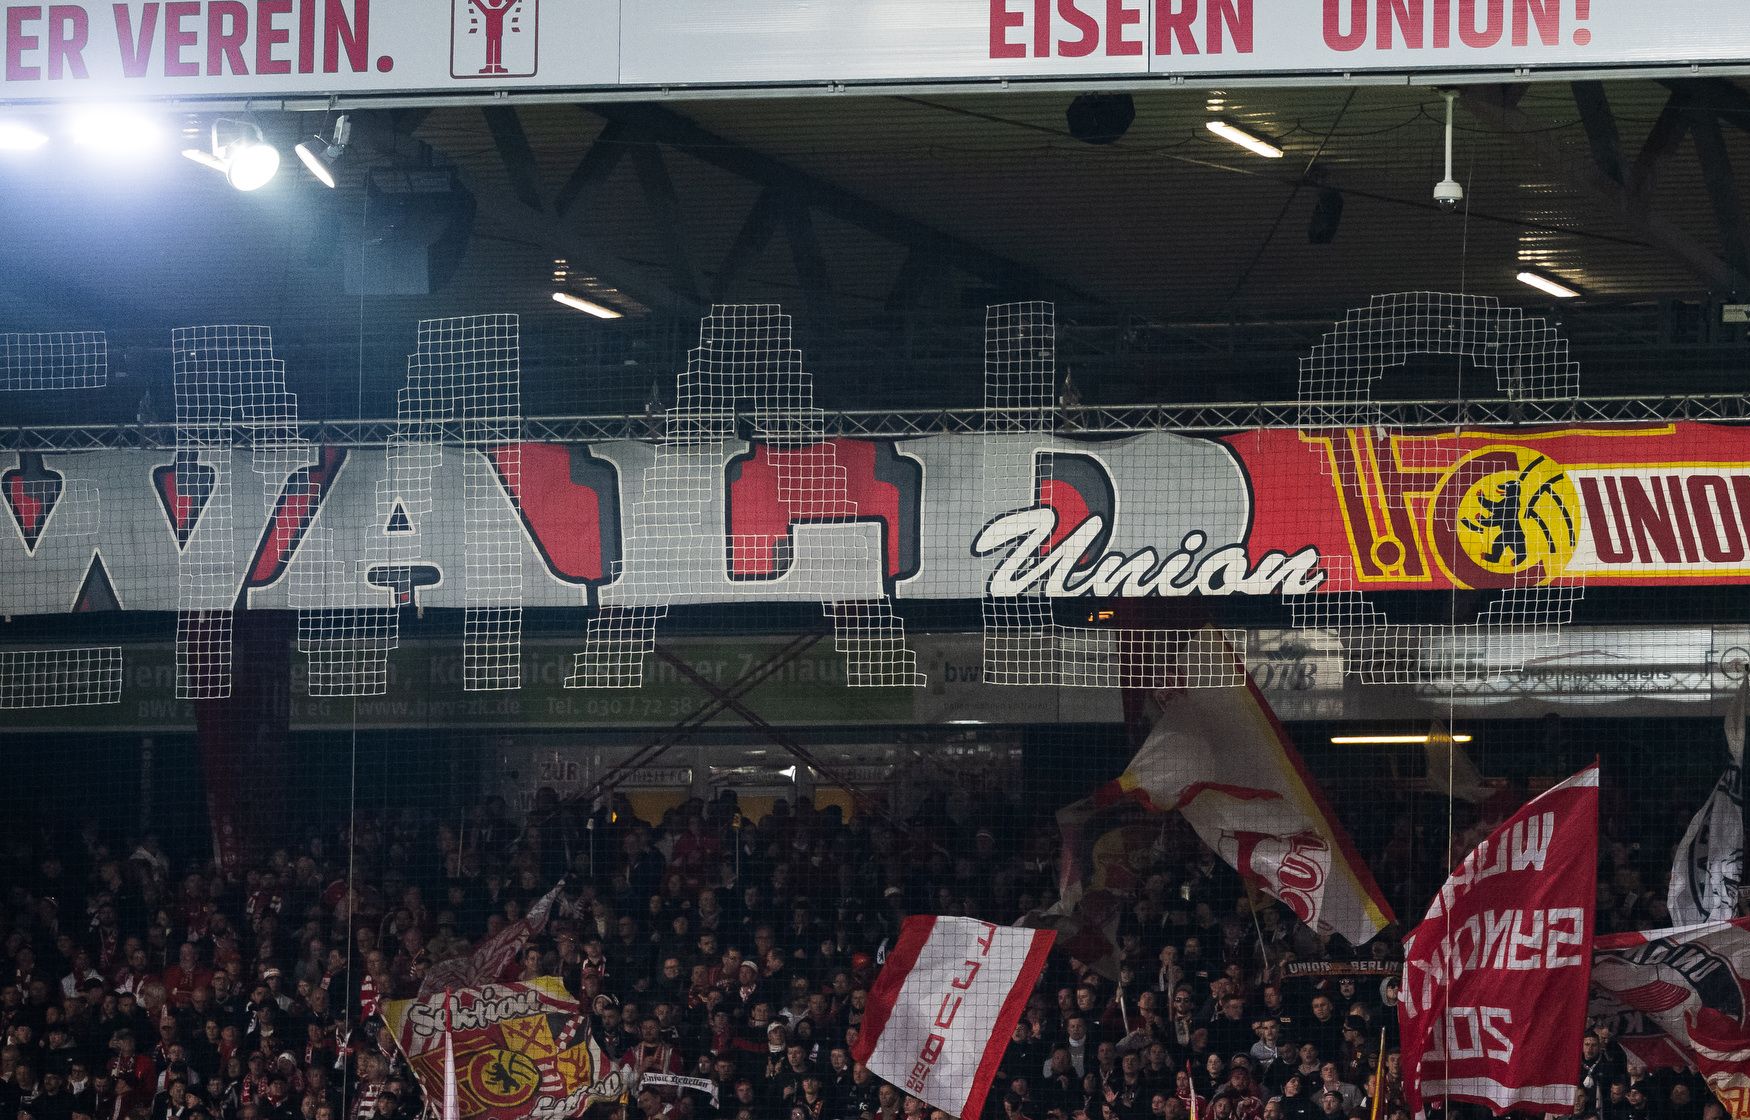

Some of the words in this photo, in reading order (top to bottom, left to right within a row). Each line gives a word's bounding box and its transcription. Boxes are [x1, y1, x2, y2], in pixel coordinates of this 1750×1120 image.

[113, 0, 394, 78] VEREIN.
[989, 0, 1254, 60] EISERN
[1322, 0, 1592, 52] UNION!
[971, 506, 1329, 599] Union
[1288, 961, 1331, 975] UNION
[1351, 959, 1399, 972] BERLIN
